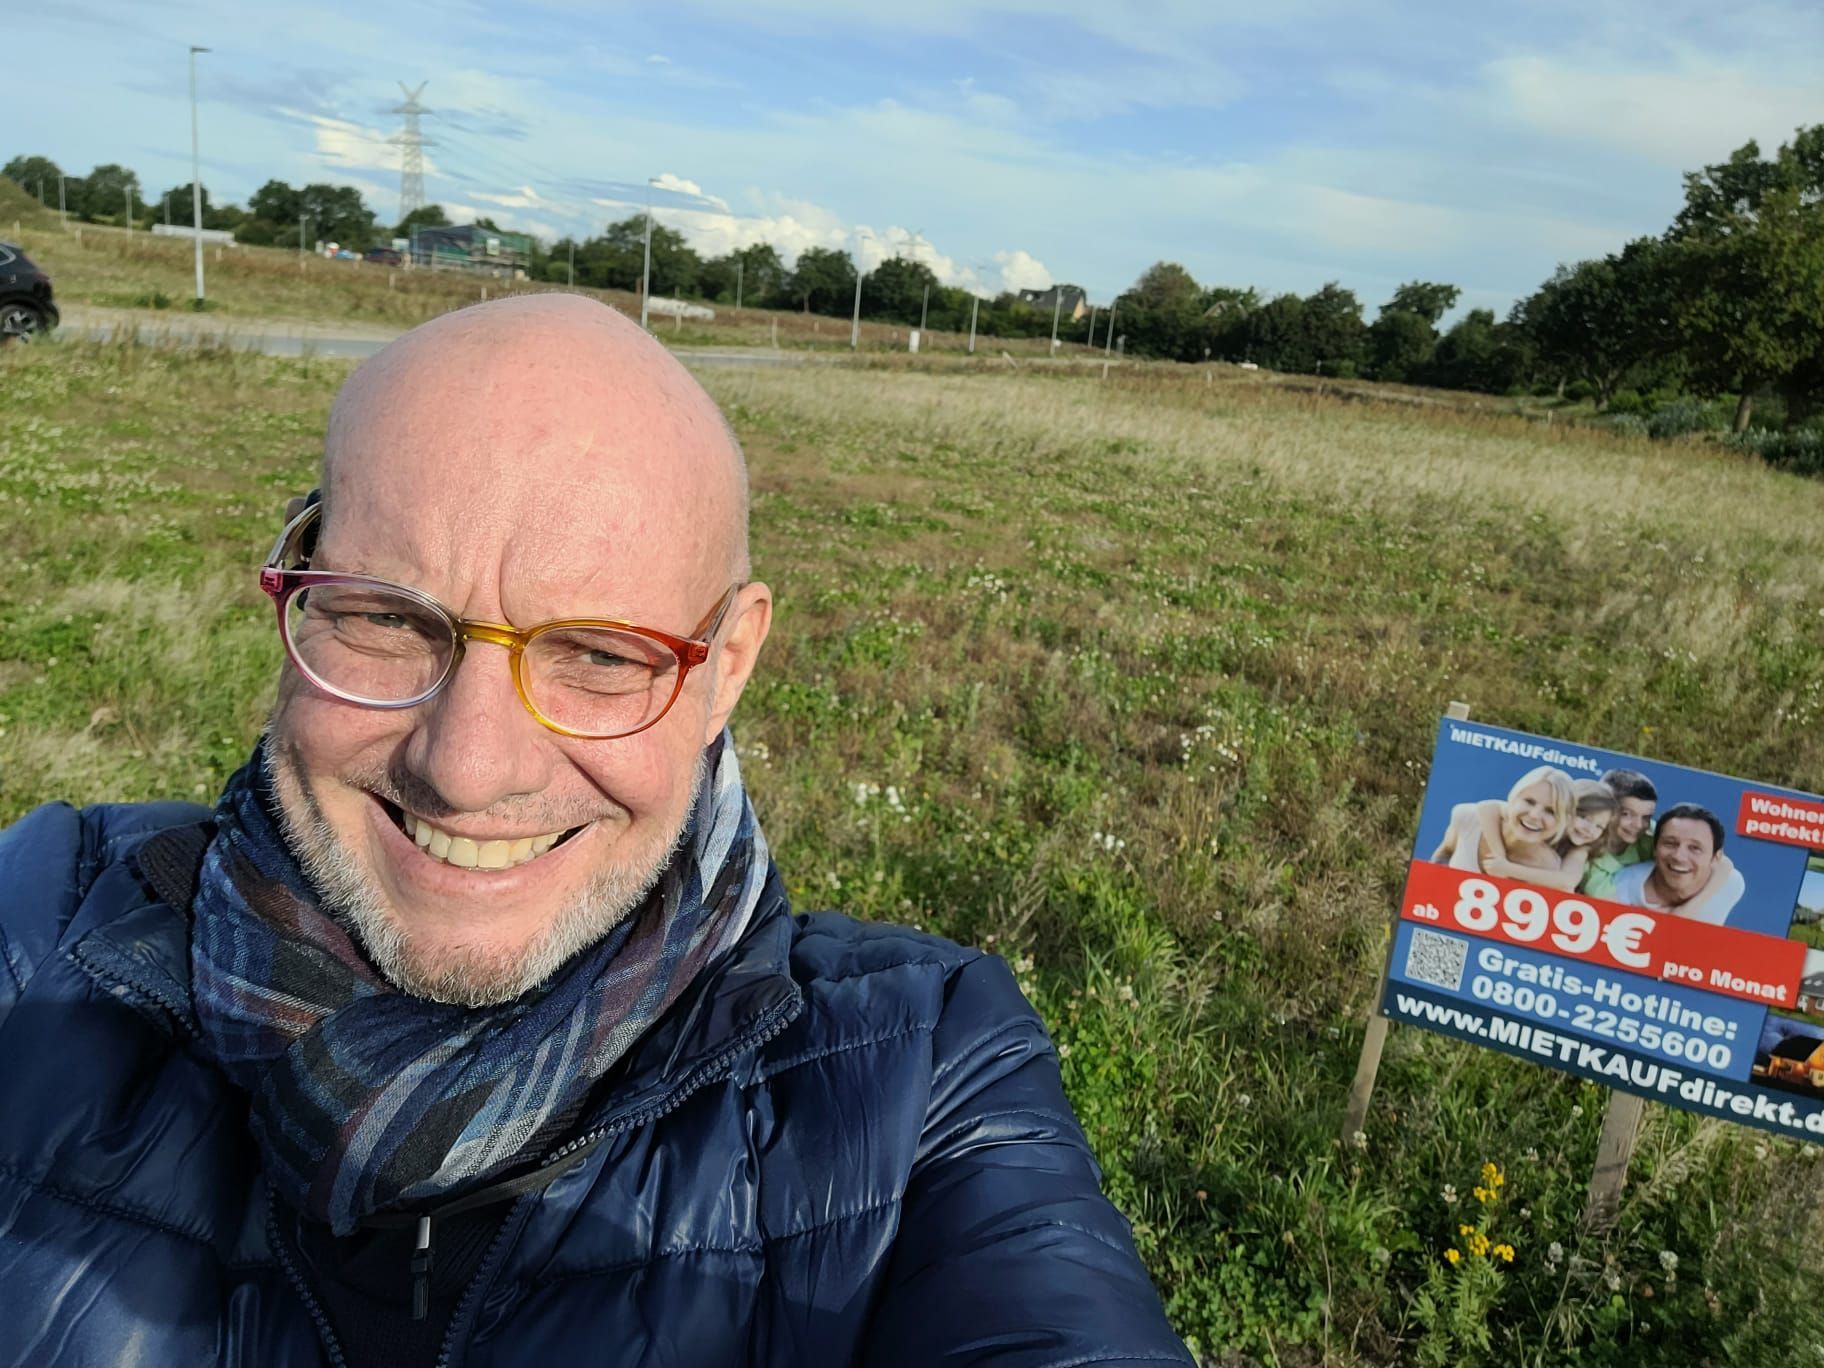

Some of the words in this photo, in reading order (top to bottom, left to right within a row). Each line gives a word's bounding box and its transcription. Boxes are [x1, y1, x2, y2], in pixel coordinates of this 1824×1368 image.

[1451, 729, 1598, 772] MIETKAUFdirekt
[1412, 903, 1440, 920] ab
[1453, 878, 1655, 968] 899€
[1662, 961, 1703, 982] pro
[1710, 968, 1787, 1001] Monat
[1472, 975, 1731, 1069] 0800-2255600
[1478, 947, 1738, 1040] Gratis-Hotline:
